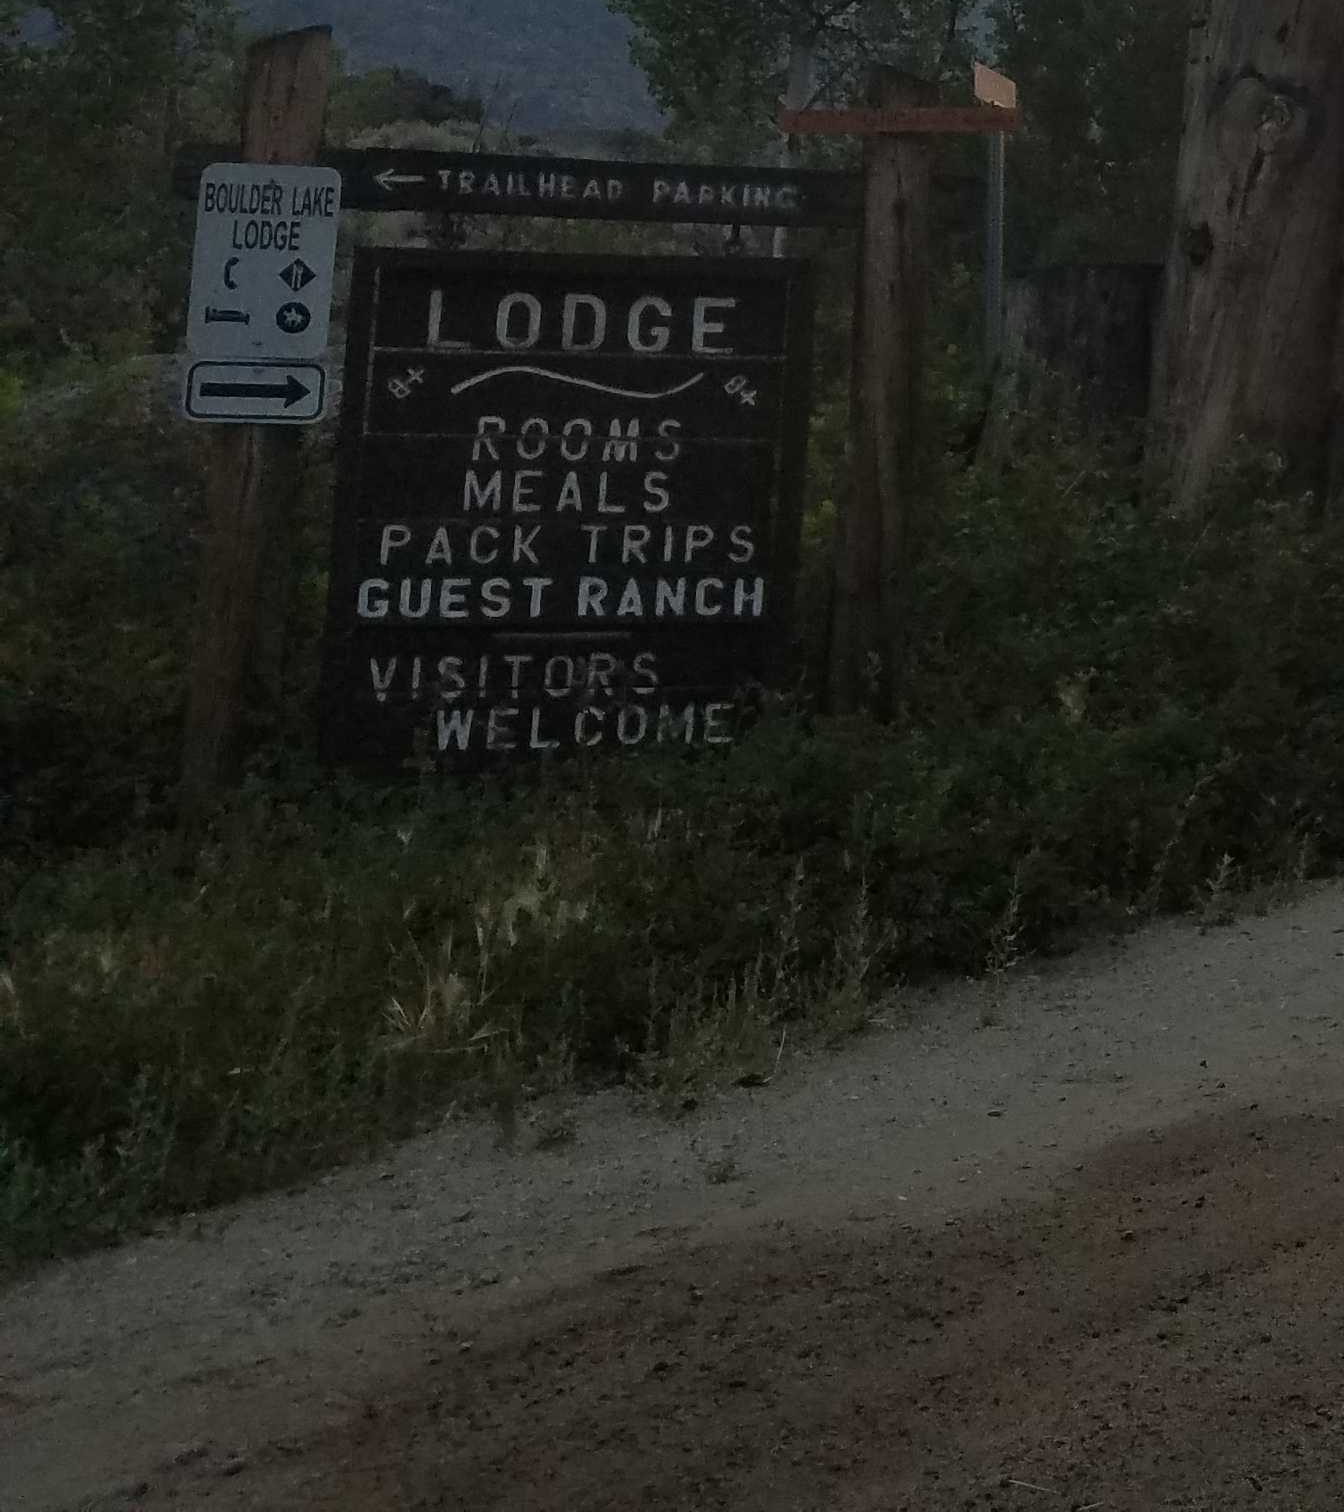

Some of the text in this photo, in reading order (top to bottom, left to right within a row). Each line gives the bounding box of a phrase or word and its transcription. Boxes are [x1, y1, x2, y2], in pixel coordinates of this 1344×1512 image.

[204, 183, 334, 217] BOULDER LAKE
[437, 170, 797, 208] TRAILHEAD PARKING
[232, 220, 300, 251] LODGE
[428, 290, 737, 355] LODGE
[472, 415, 682, 463] ROOMS
[463, 471, 670, 514] MEALS
[380, 524, 755, 565] PACK TRIPS
[357, 577, 765, 619] GUEST RANCH
[370, 651, 659, 701] VISITORS
[436, 702, 736, 751] WELCOME
